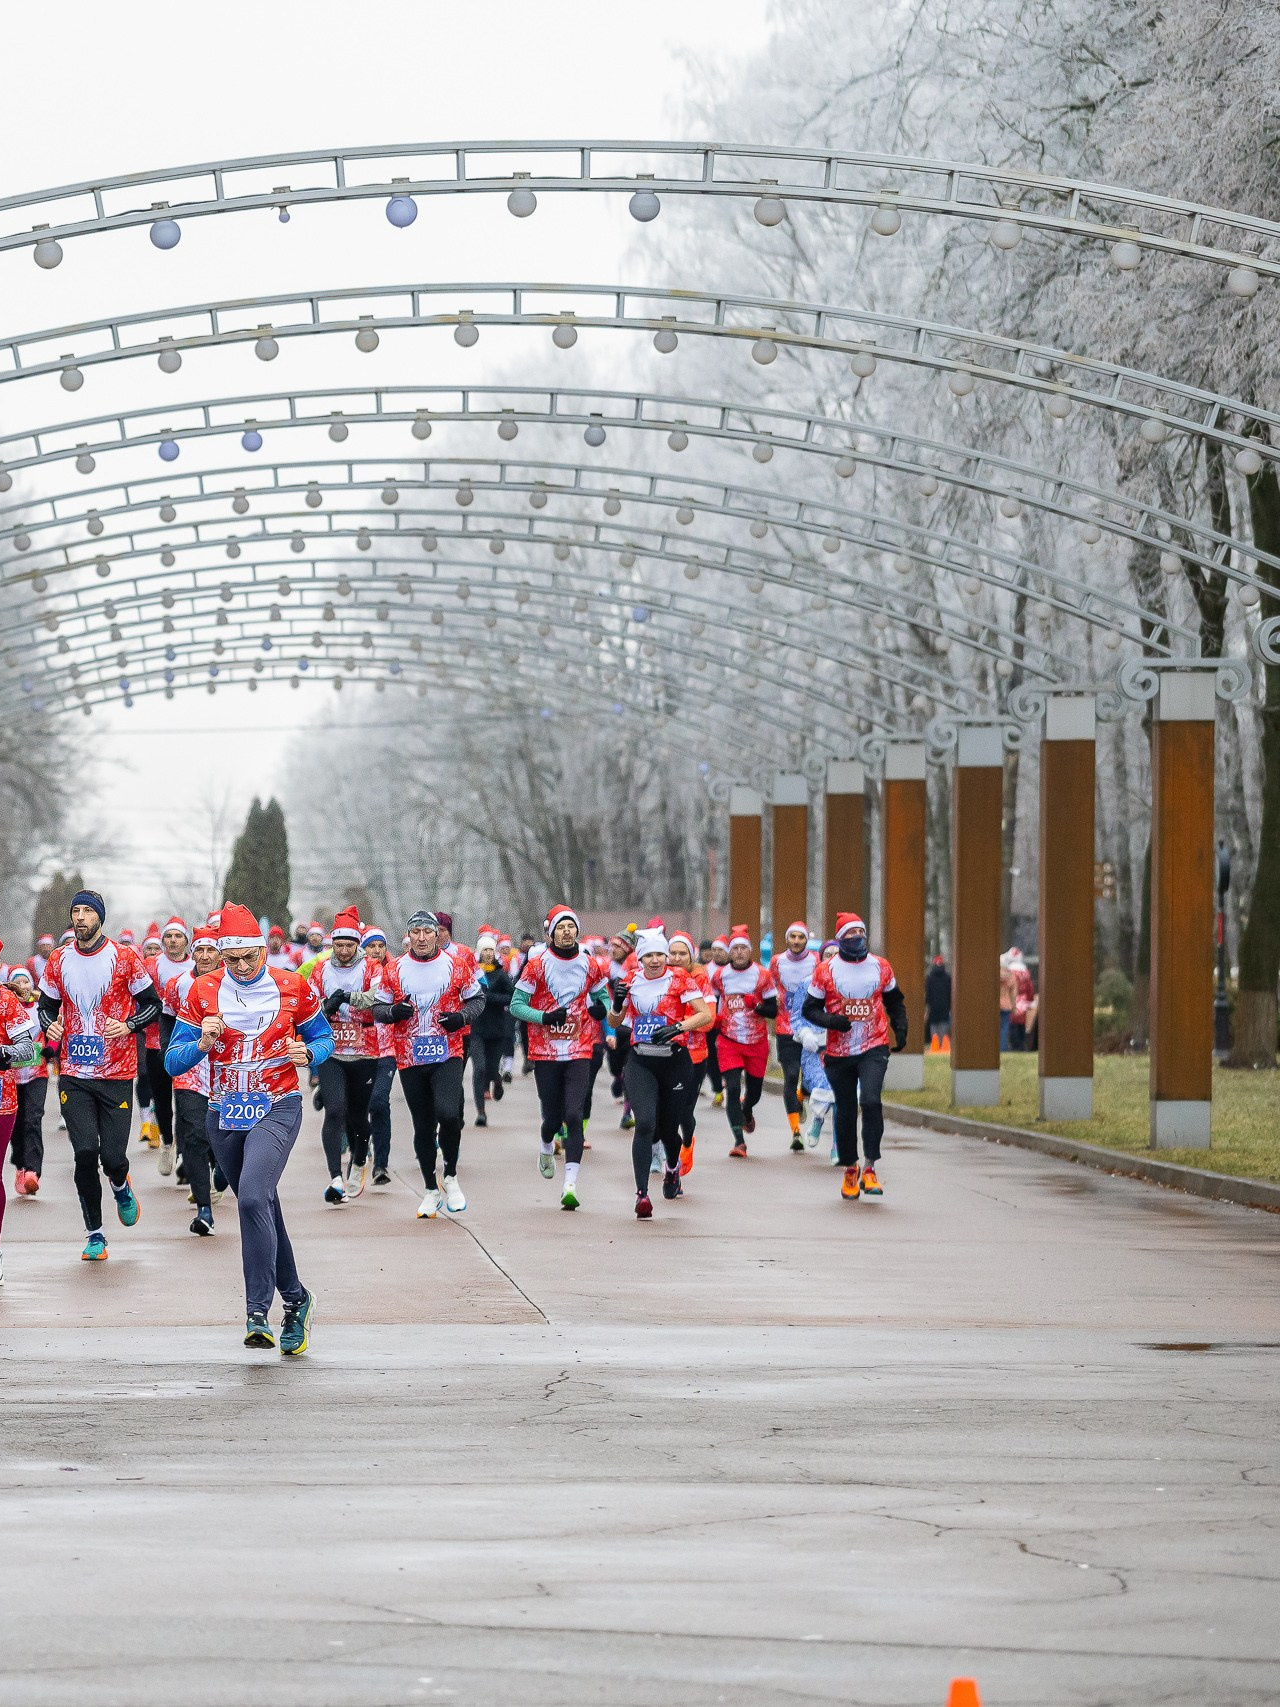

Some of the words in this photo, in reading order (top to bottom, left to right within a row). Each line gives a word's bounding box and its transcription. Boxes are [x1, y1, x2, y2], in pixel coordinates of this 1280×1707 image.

[845, 1004, 870, 1017] 5033
[549, 1022, 575, 1034] 5027
[333, 1029, 356, 1041] 5132
[71, 1043, 100, 1057] 2034
[417, 1044, 444, 1057] 2238
[225, 1104, 266, 1120] 2206
